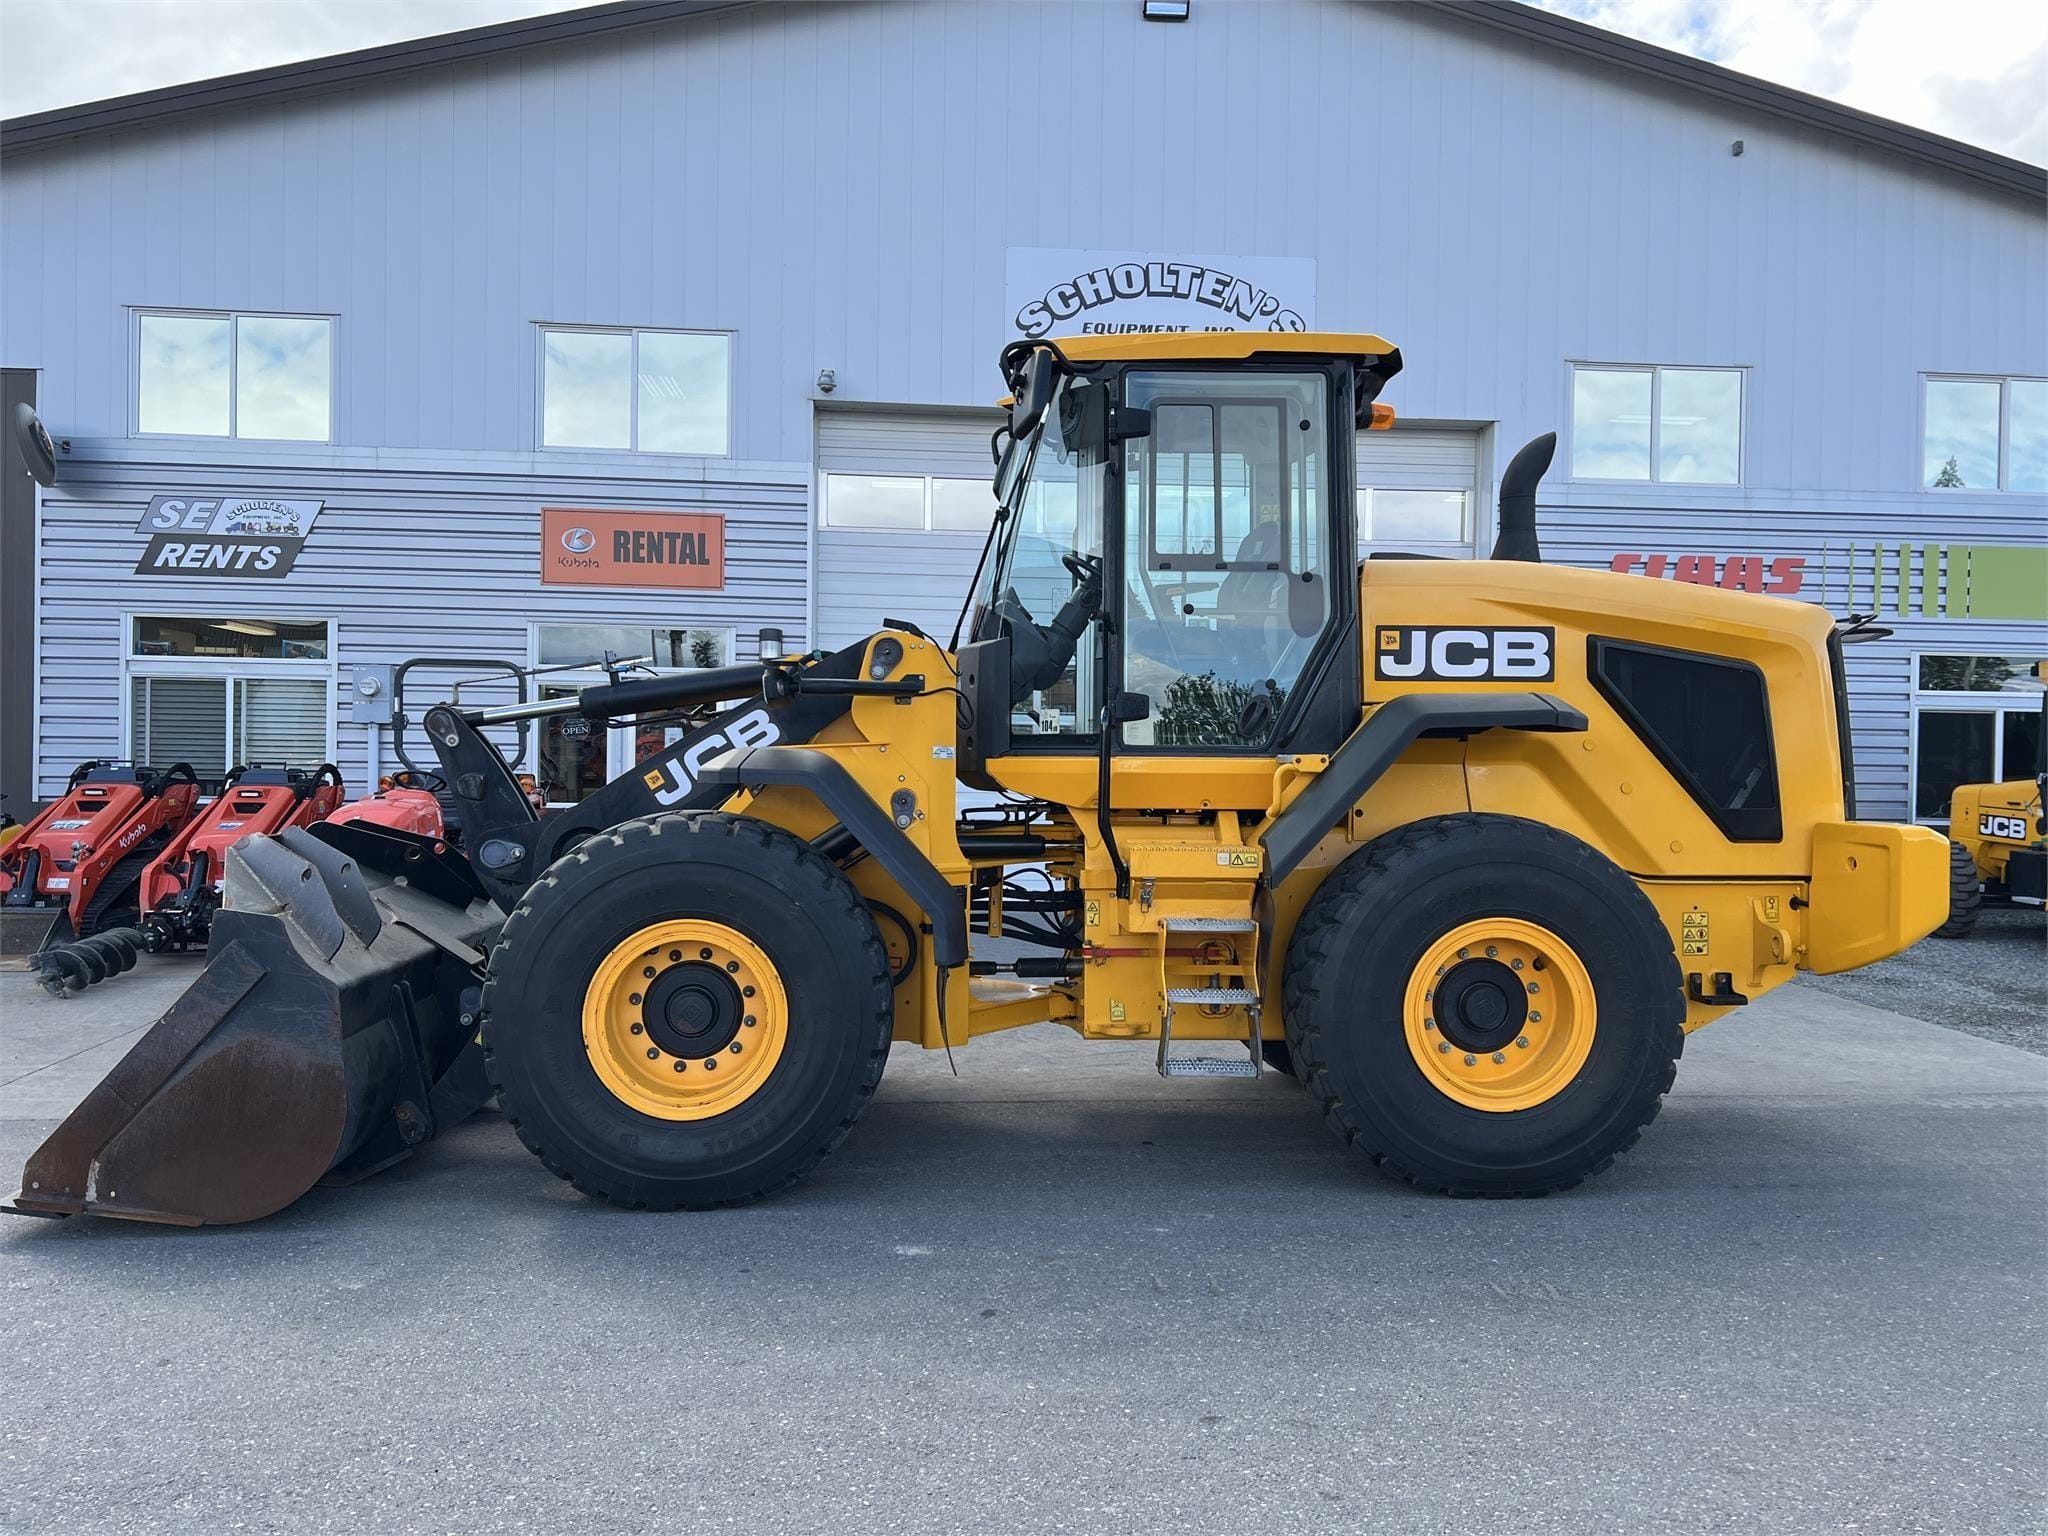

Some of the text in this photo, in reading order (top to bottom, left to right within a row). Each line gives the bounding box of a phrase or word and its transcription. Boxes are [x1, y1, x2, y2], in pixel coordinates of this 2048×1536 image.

[1015, 262, 1306, 339] SCHOLTEN'S
[151, 499, 219, 531] SE
[225, 500, 301, 522] SCHOLTEN'S
[153, 543, 282, 571] RENTS
[613, 530, 710, 566] RENTAL
[558, 556, 600, 568] Kubota
[1380, 630, 1551, 678] JCB
[562, 726, 589, 735] OPEN
[1041, 719, 1053, 732] 104
[654, 709, 781, 806] JCB
[118, 823, 147, 848] Kubota
[1980, 816, 2026, 839] JCB
